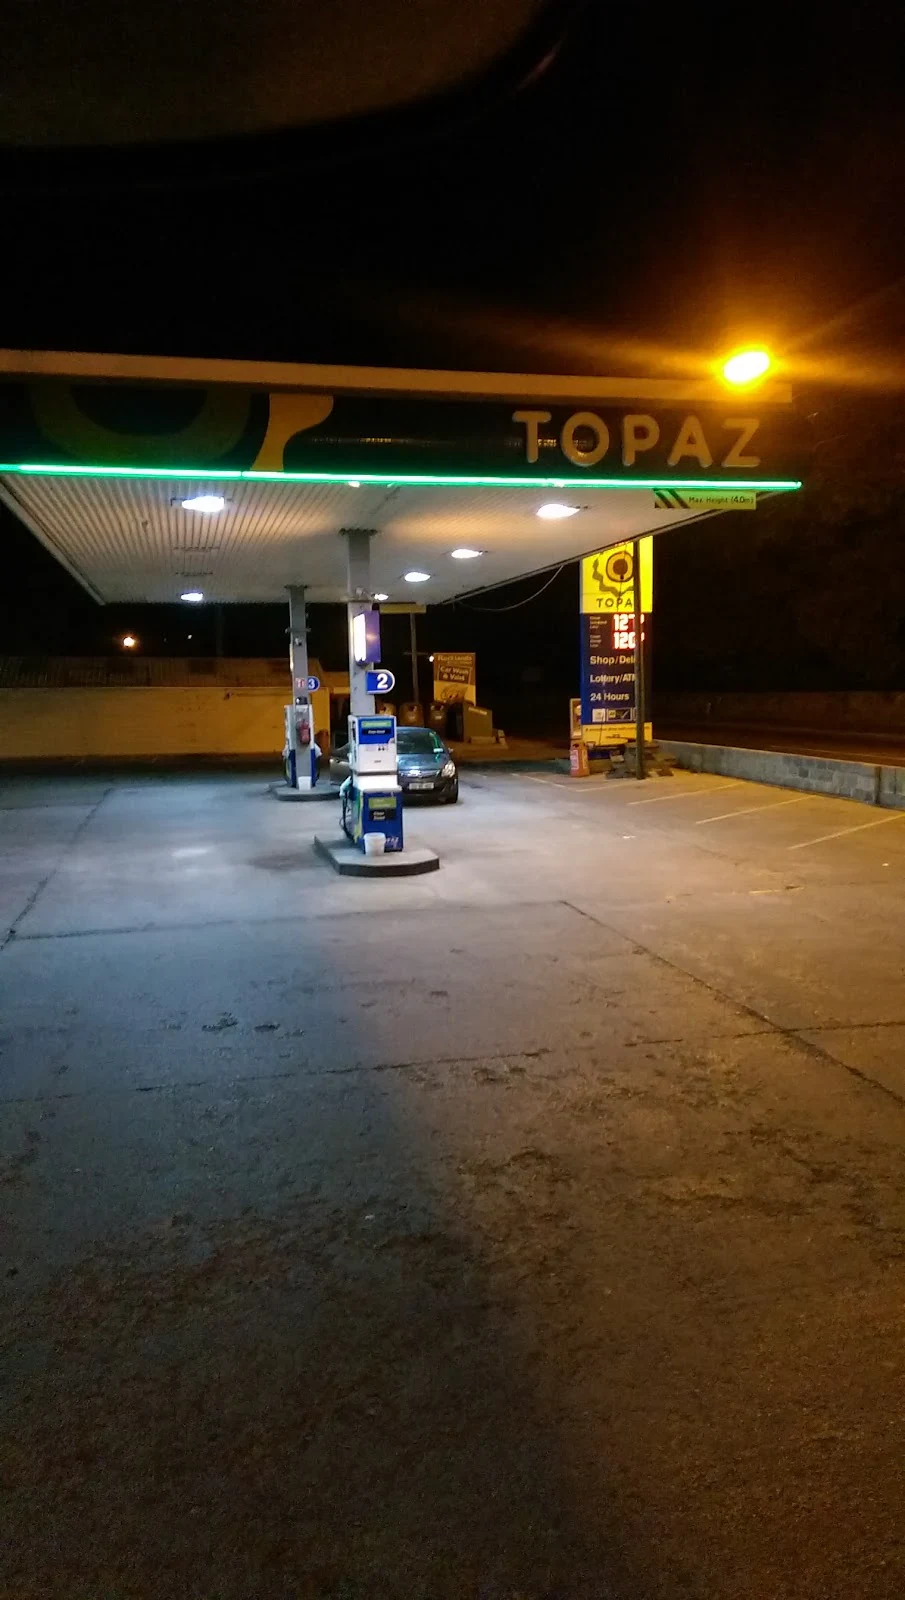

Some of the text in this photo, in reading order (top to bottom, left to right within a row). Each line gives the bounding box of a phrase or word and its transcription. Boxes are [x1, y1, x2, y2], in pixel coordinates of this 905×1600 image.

[511, 410, 762, 468] TOPAZ
[596, 598, 633, 609] TOPA
[308, 678, 316, 689] 3
[376, 673, 389, 689] 2
[590, 692, 630, 702] 24 Hours
